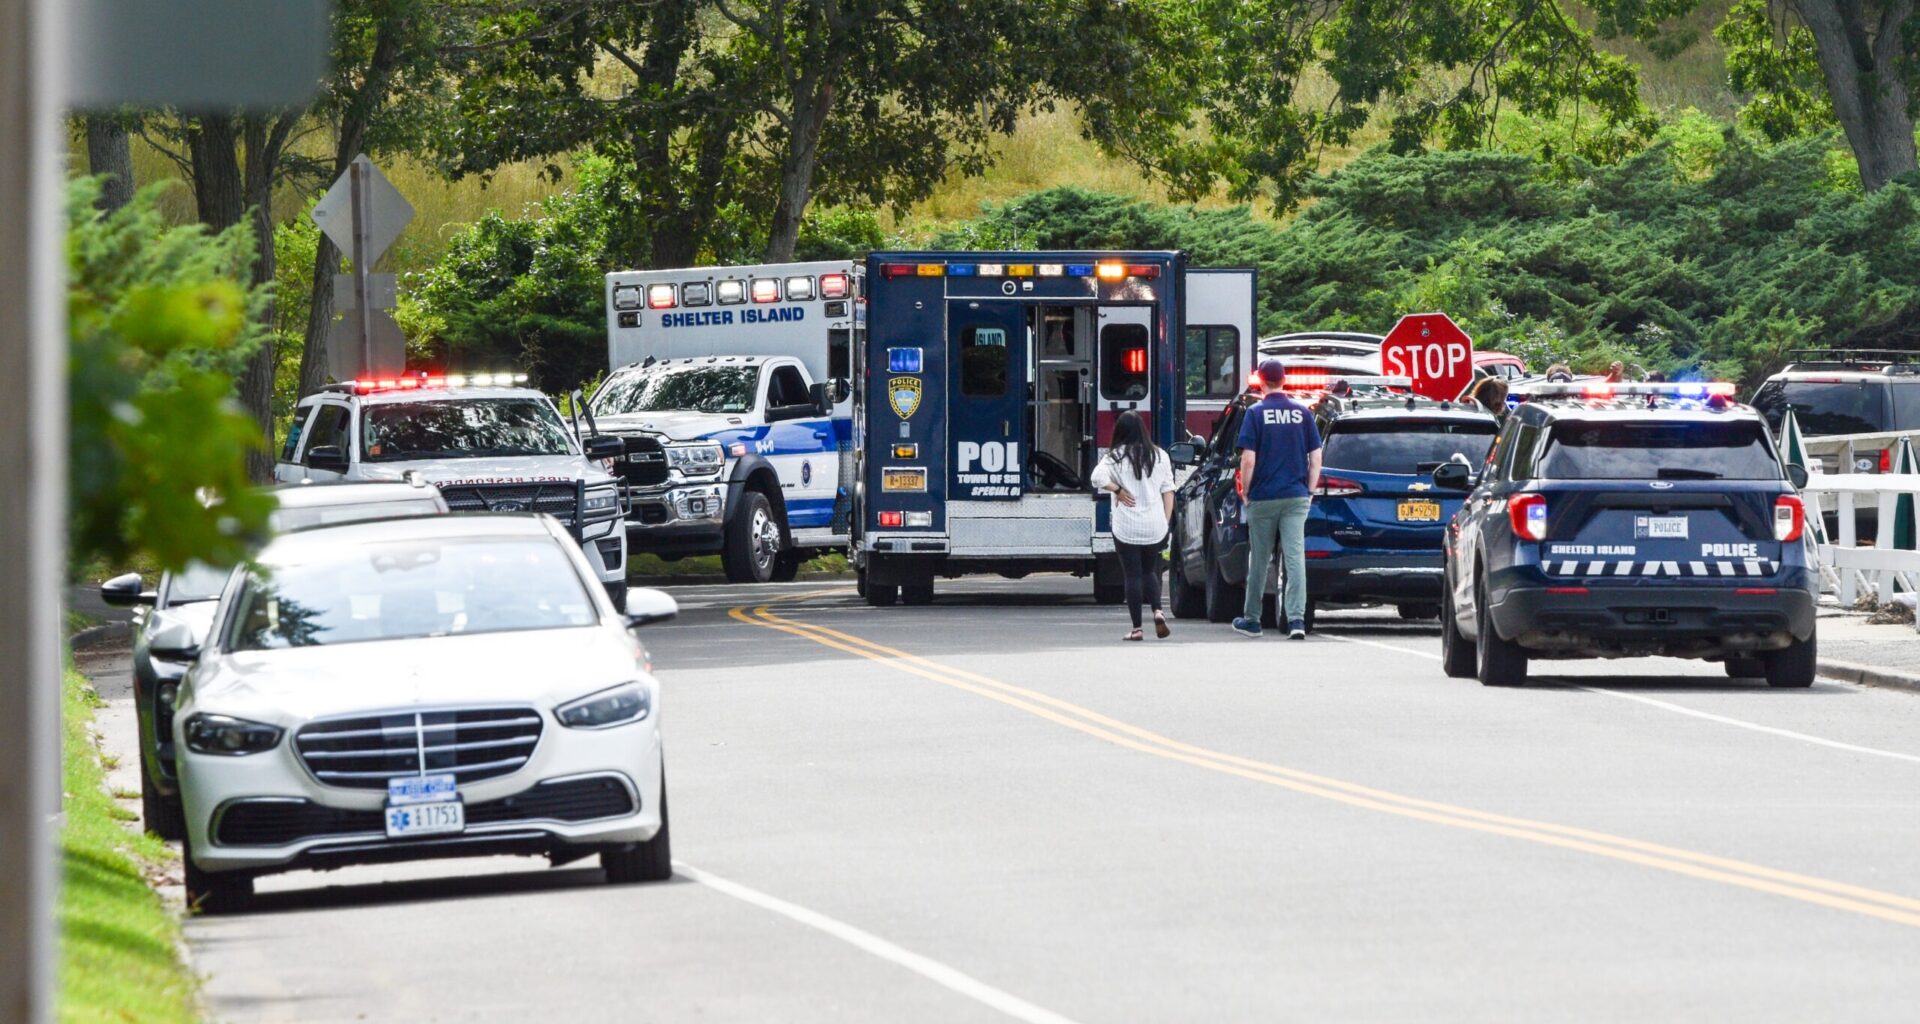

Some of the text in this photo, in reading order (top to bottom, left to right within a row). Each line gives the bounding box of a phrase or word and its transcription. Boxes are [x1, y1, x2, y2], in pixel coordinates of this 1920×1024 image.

[661, 307, 805, 328] SHELTER ISLAND
[1387, 343, 1466, 380] STOP
[1263, 409, 1304, 425] EMS
[957, 441, 1020, 473] POL
[957, 474, 988, 484] TOWN
[990, 474, 1003, 484] OF
[971, 486, 1009, 496] SPECIAL
[1654, 522, 1682, 534] POLICE
[1551, 545, 1636, 555] SHELTER ISLAND
[1702, 544, 1757, 557] POLICE
[426, 806, 458, 826] 1753
